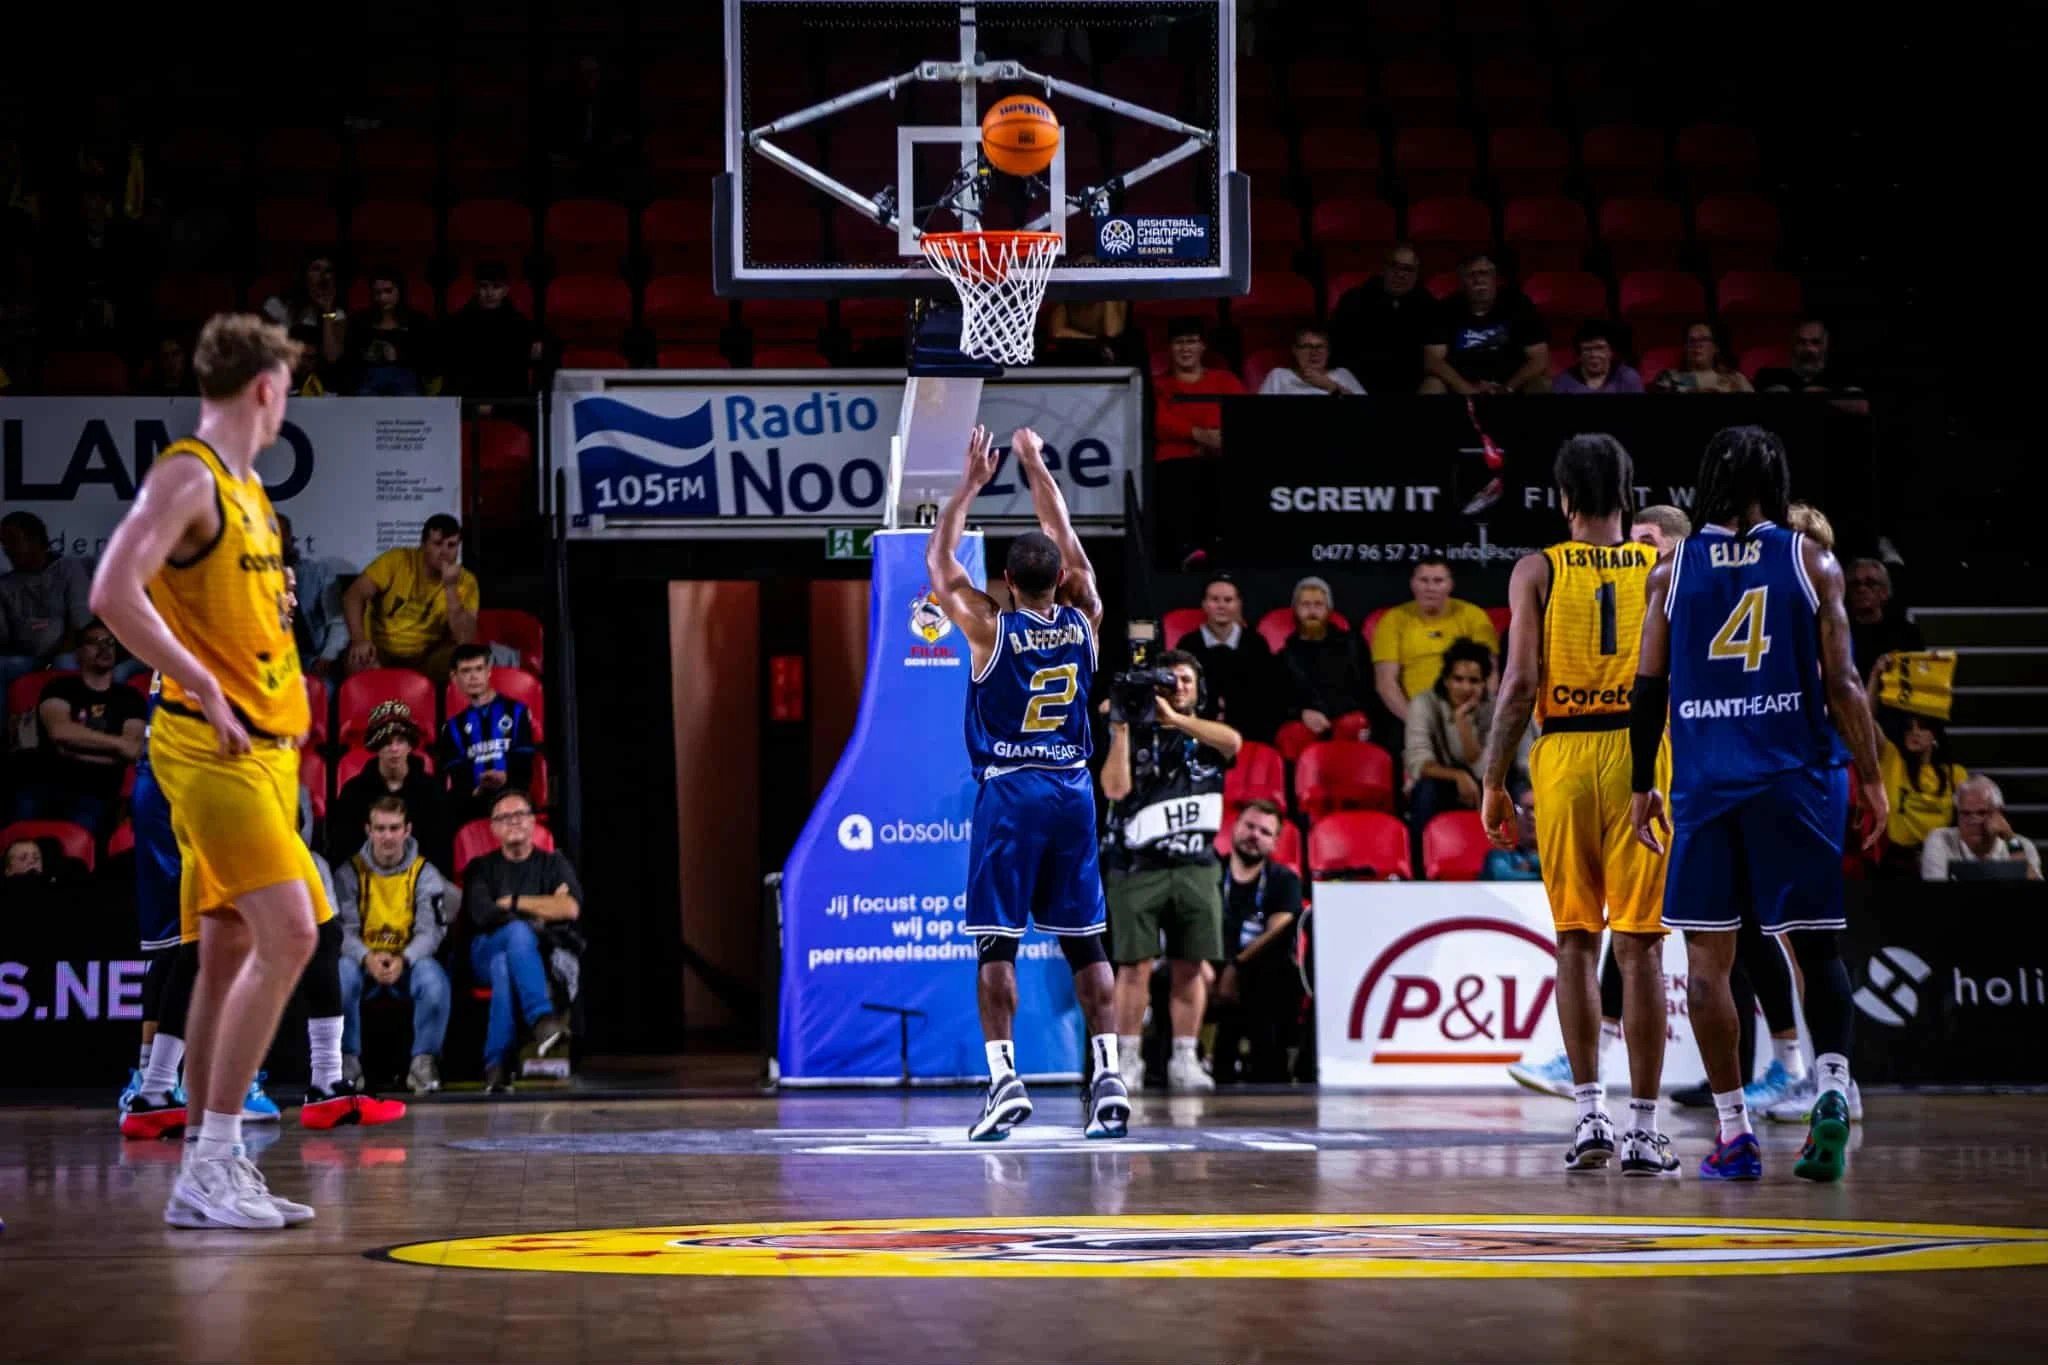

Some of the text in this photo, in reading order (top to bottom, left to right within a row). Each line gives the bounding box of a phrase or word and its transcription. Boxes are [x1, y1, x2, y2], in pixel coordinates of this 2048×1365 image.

[1137, 219, 1197, 227] BASKETBALL
[1137, 228, 1204, 241] CHAMPIONS
[1137, 237, 1174, 245] LEAGUE
[725, 391, 877, 441] Radio
[595, 473, 705, 508] 105FM
[1269, 486, 1441, 512] SCREW IT
[1312, 544, 1353, 560] 0477
[1358, 544, 1379, 560] 96
[1385, 544, 1405, 560] 57
[1565, 550, 1647, 569] ESTRADA
[1710, 540, 1763, 567] ELLIS
[1595, 581, 1617, 656] 1
[1708, 585, 1772, 673] 4
[1021, 663, 1079, 733] 2
[1553, 684, 1633, 705] Coret
[1679, 692, 1802, 719] GIANTHEART
[1164, 802, 1201, 831] HB
[880, 818, 973, 844] absolut
[825, 895, 848, 918] Jij
[854, 894, 917, 915] focust
[921, 896, 950, 915] op
[892, 917, 923, 941] wij
[926, 920, 954, 940] op
[1378, 974, 1557, 1041] P&V
